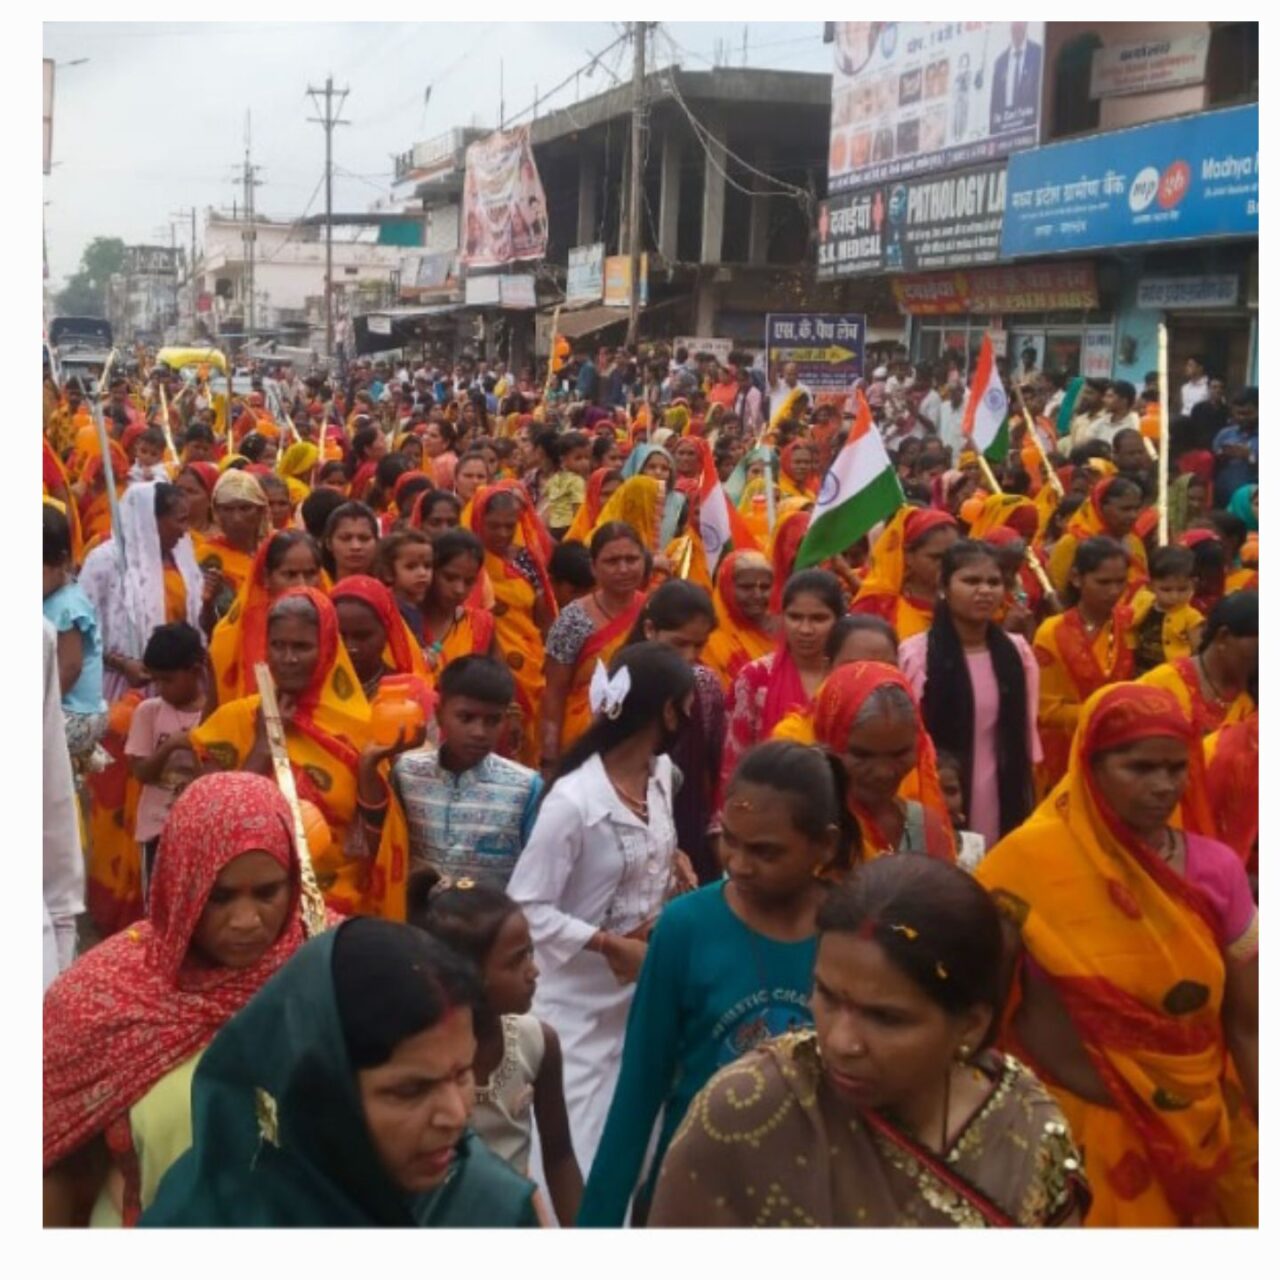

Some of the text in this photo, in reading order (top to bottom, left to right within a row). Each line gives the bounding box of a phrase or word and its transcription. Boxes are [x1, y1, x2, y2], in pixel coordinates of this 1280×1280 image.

[1202, 154, 1252, 181] Madhya
[907, 172, 987, 225] PATHOLOGY
[838, 234, 881, 260] MEDICAL
